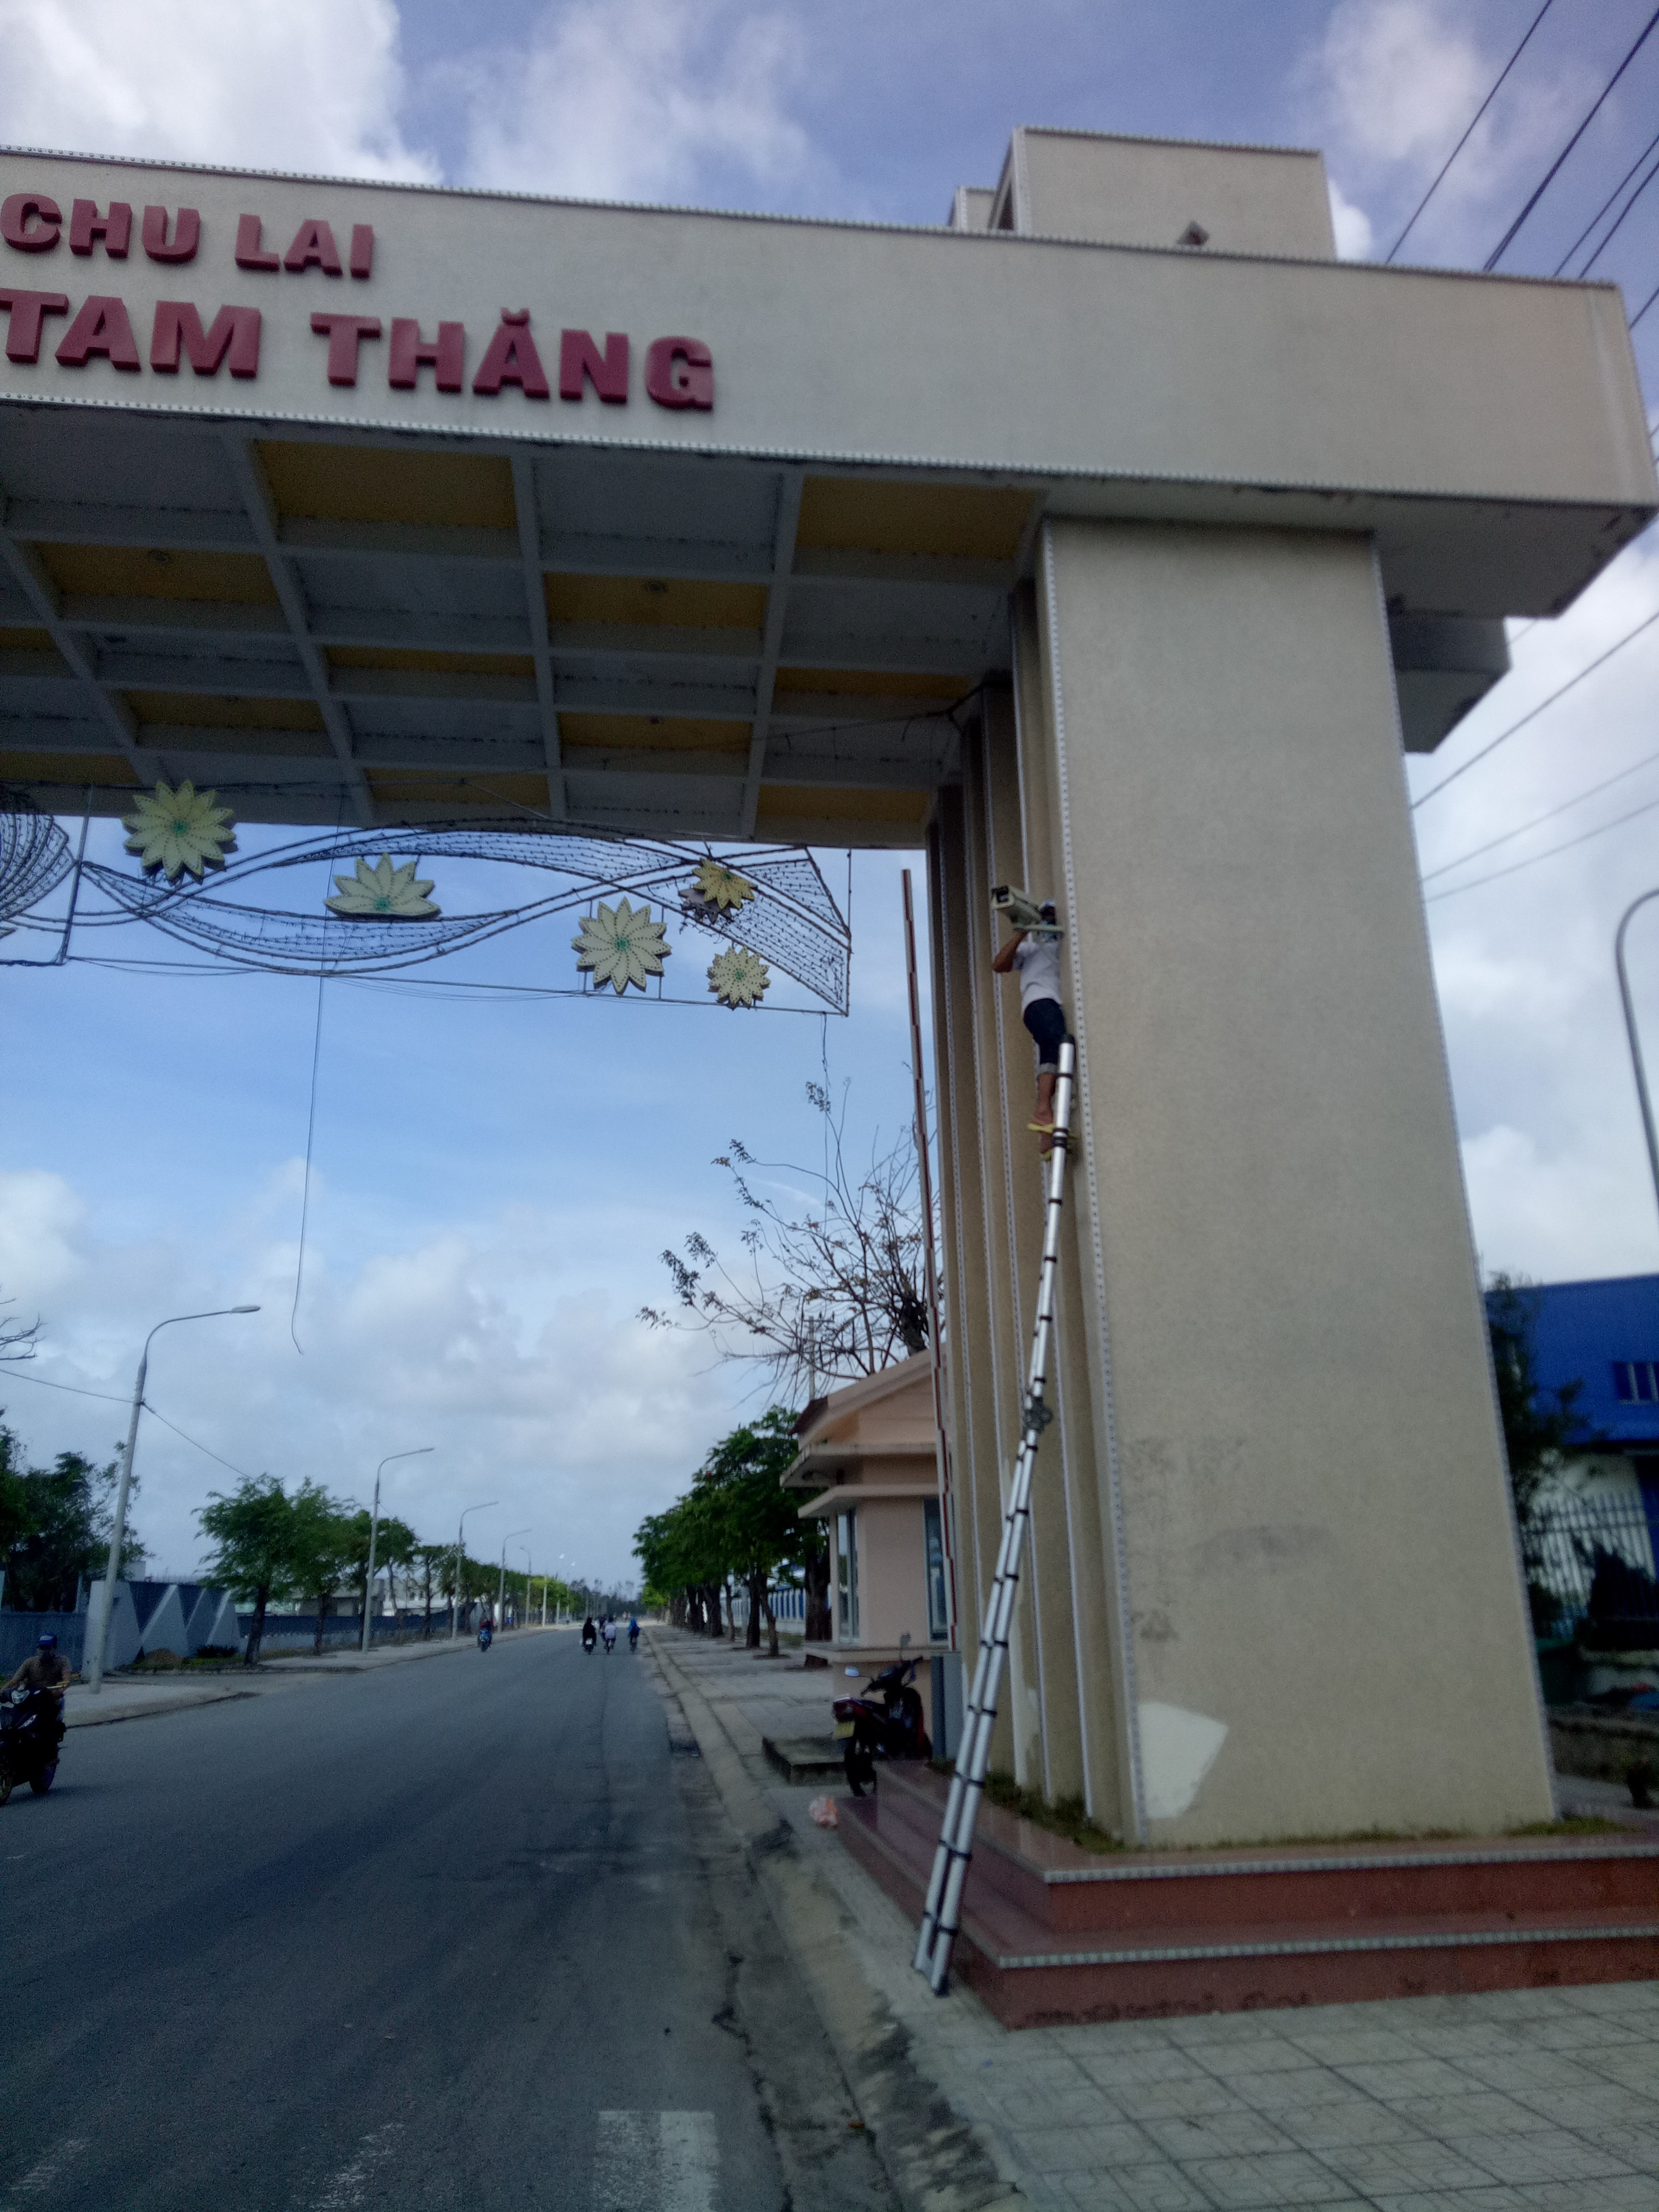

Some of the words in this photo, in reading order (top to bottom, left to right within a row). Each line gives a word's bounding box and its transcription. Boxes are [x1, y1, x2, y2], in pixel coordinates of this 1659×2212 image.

[0, 194, 201, 263] CHU
[236, 214, 374, 279] LAI
[0, 288, 262, 379] TAM
[310, 307, 714, 410] THĂNG
